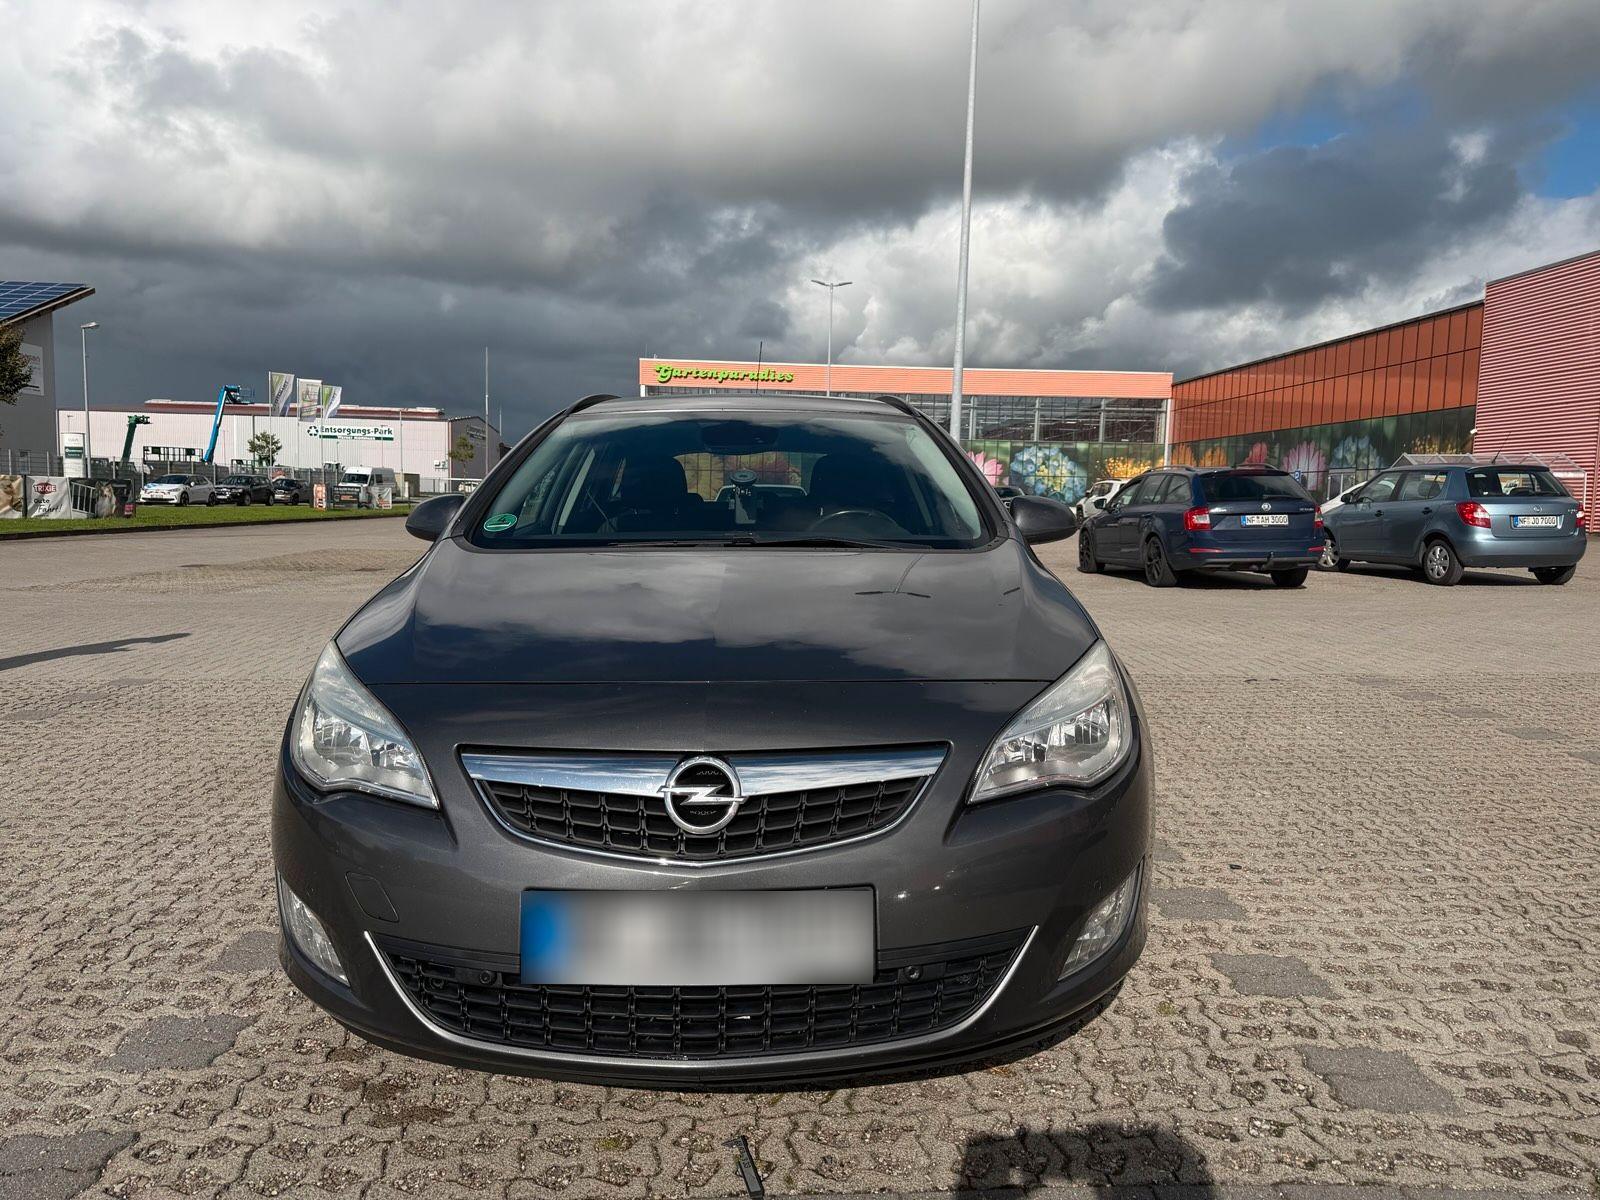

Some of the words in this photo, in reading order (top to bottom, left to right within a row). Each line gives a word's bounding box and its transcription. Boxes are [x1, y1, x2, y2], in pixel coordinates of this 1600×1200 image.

[655, 364, 794, 383] Gartenparadies
[320, 426, 393, 436] Entsorgungs-Park
[34, 484, 57, 493] TRIXIE
[38, 504, 62, 513] Fahrt!
